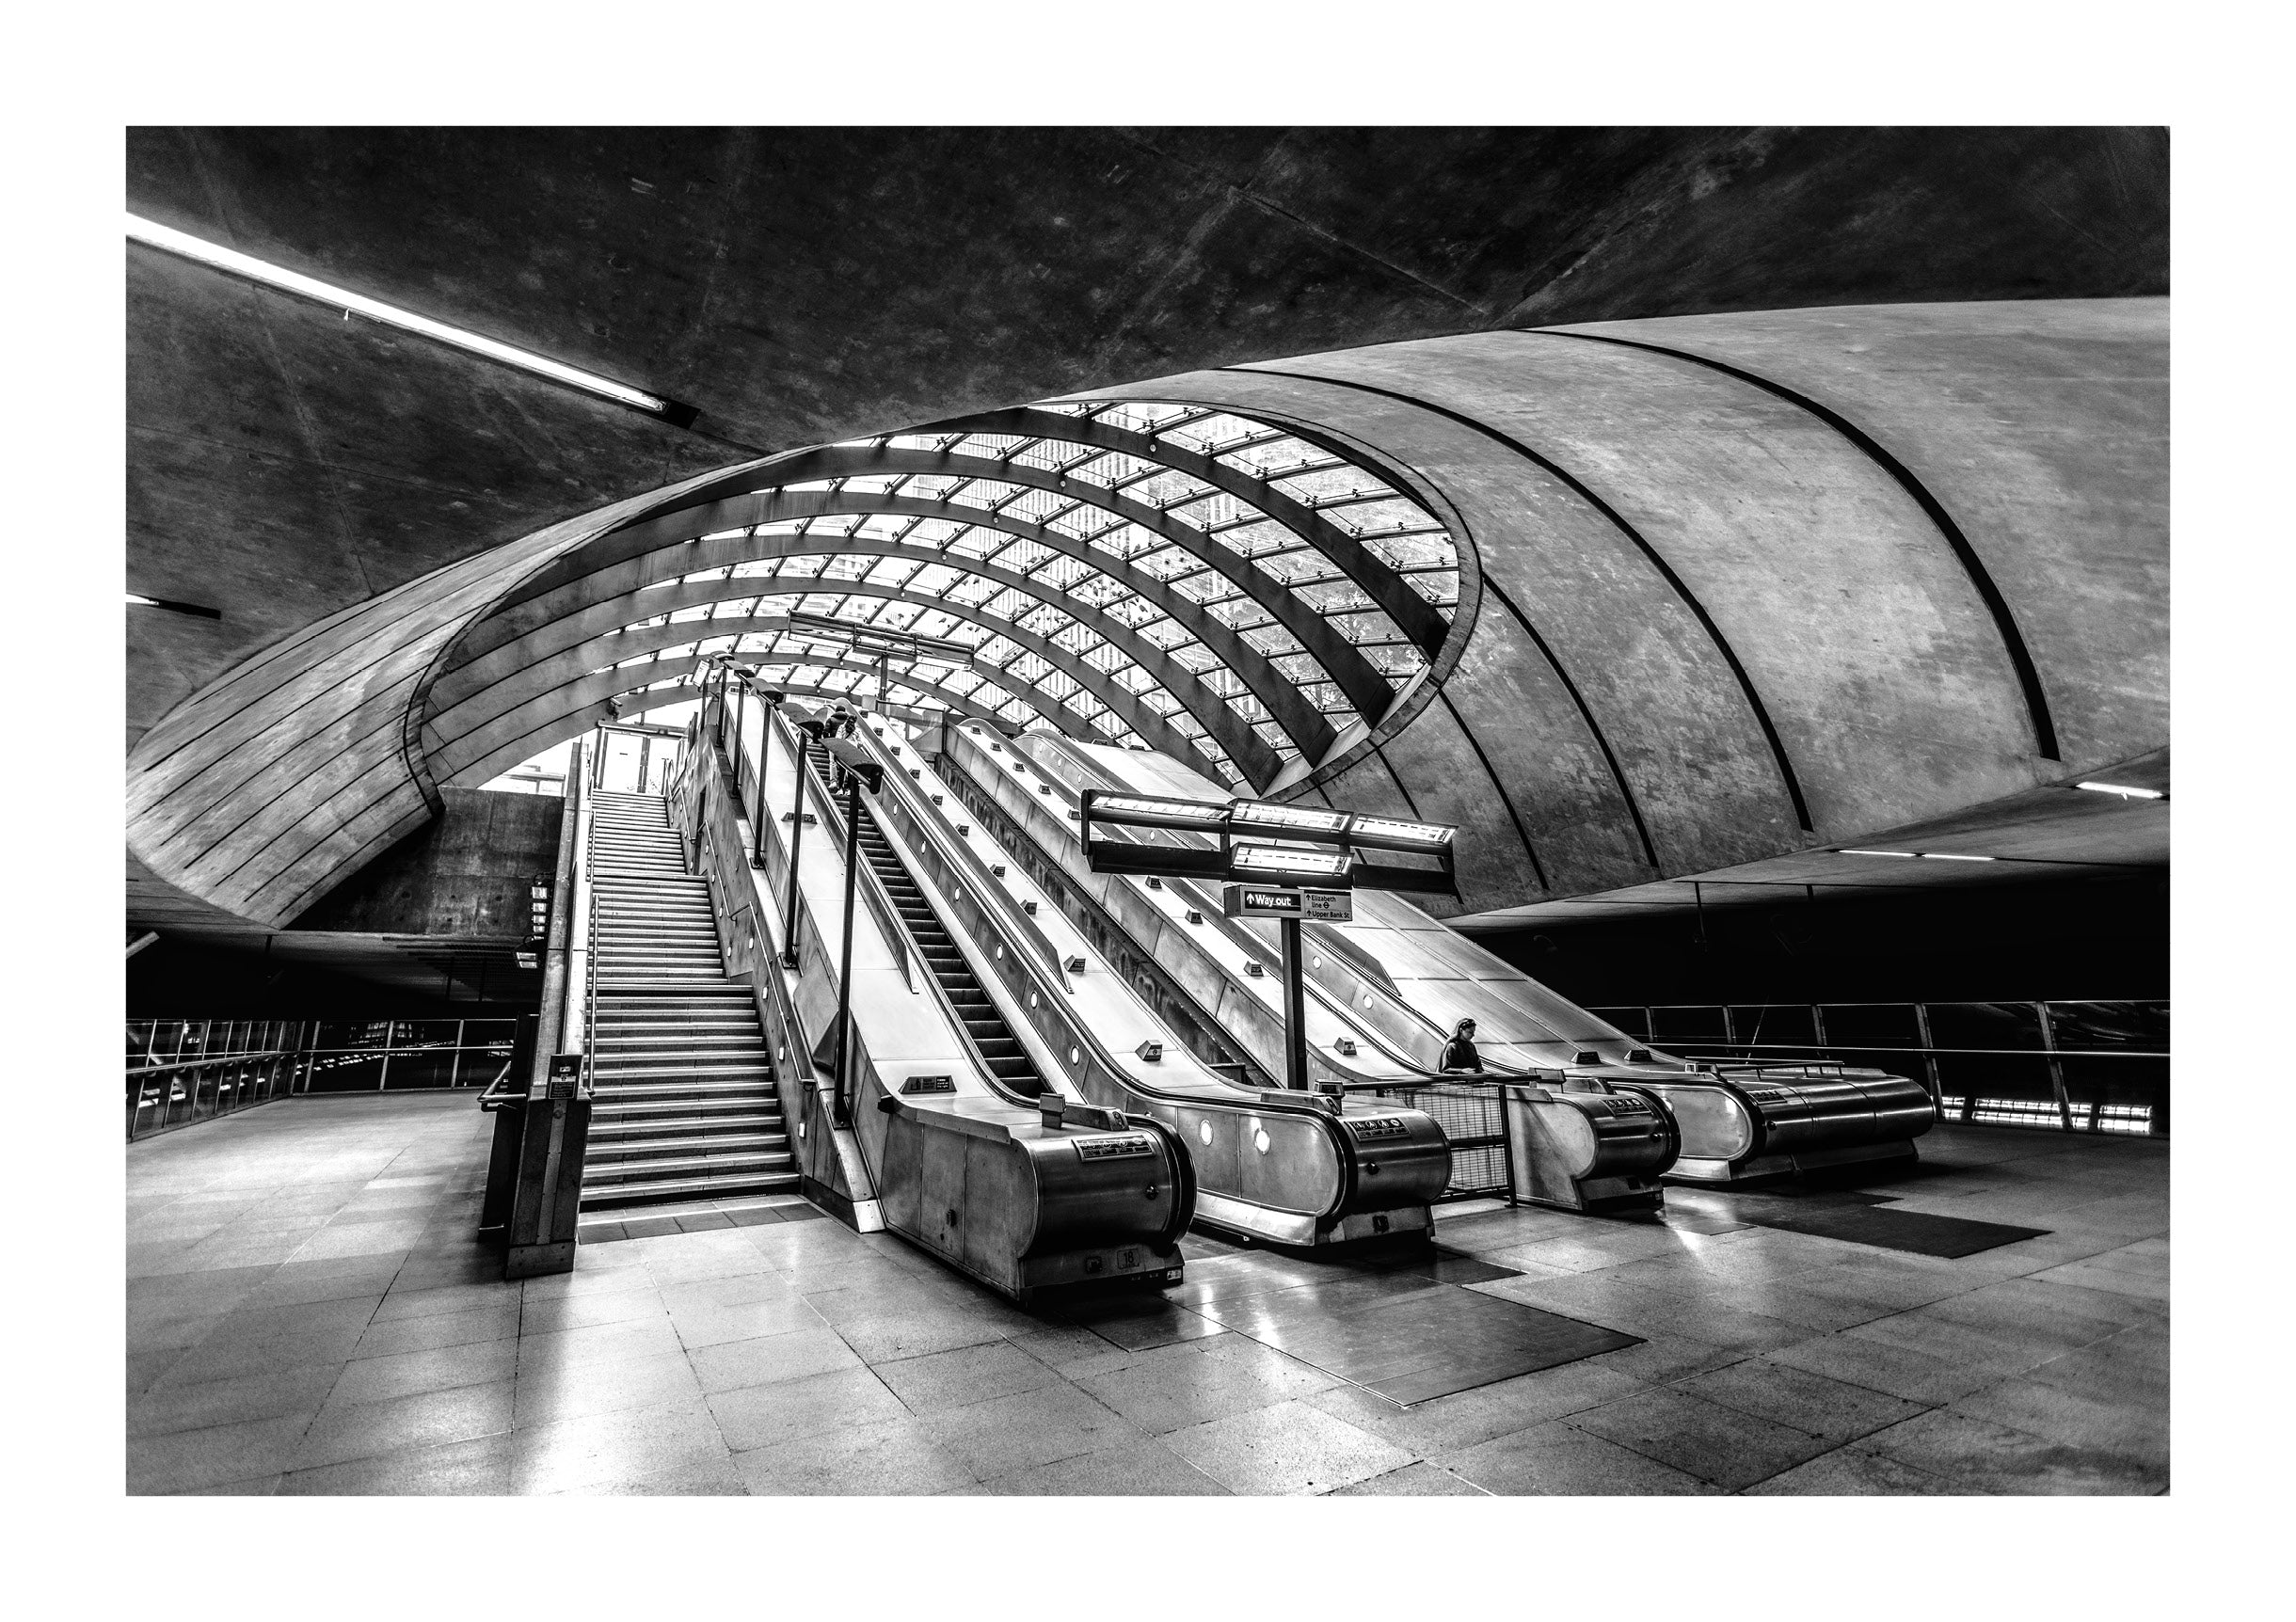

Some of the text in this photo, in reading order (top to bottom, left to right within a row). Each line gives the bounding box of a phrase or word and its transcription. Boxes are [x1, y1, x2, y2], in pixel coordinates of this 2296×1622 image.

[1255, 894, 1292, 907] Way out
[1124, 1250, 1135, 1264] 18
